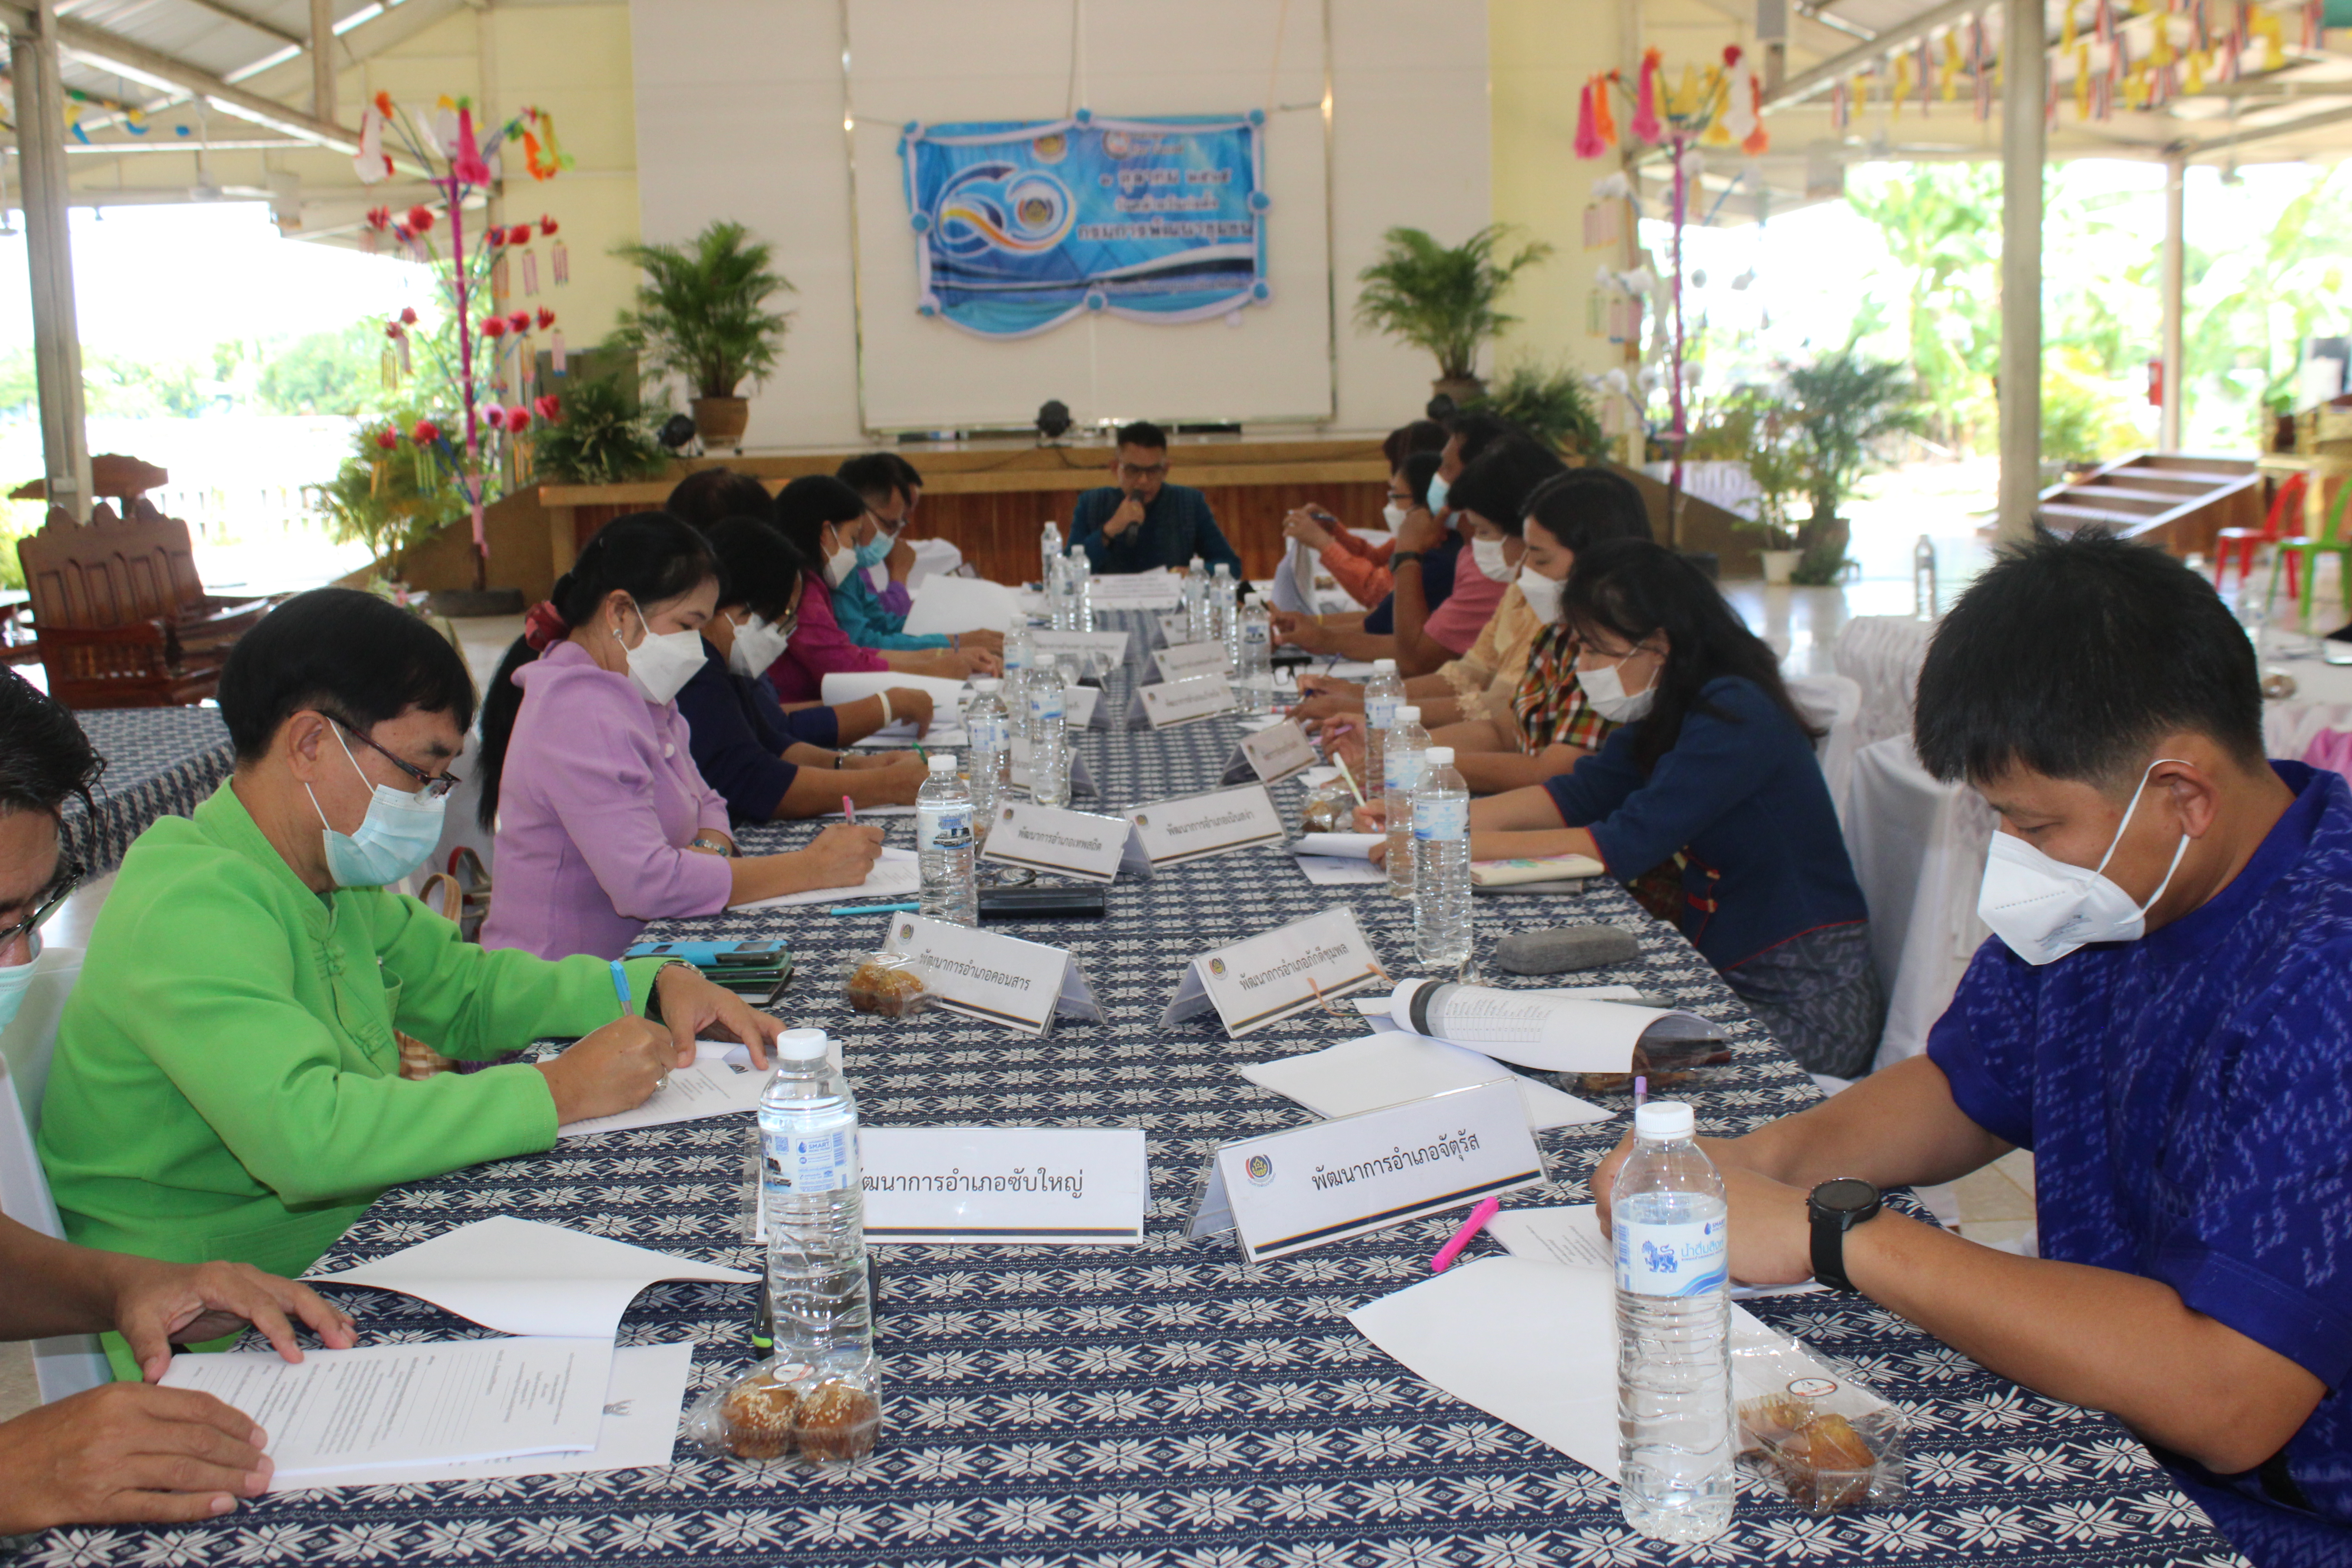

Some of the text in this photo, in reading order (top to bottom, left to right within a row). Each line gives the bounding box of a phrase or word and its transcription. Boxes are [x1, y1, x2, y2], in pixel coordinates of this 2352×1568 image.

[919, 949, 1031, 991] พัฒนาการอำเภอคอนสาร
[1240, 944, 1349, 991] พัฒนาการอำเภอภักดีชุมพล
[808, 1141, 830, 1149] SMART
[1312, 1129, 1480, 1191] พัฒนาการอำเภอจัตุรัส
[861, 1167, 1083, 1199] ฒนาการอำเภอซับใหญ่
